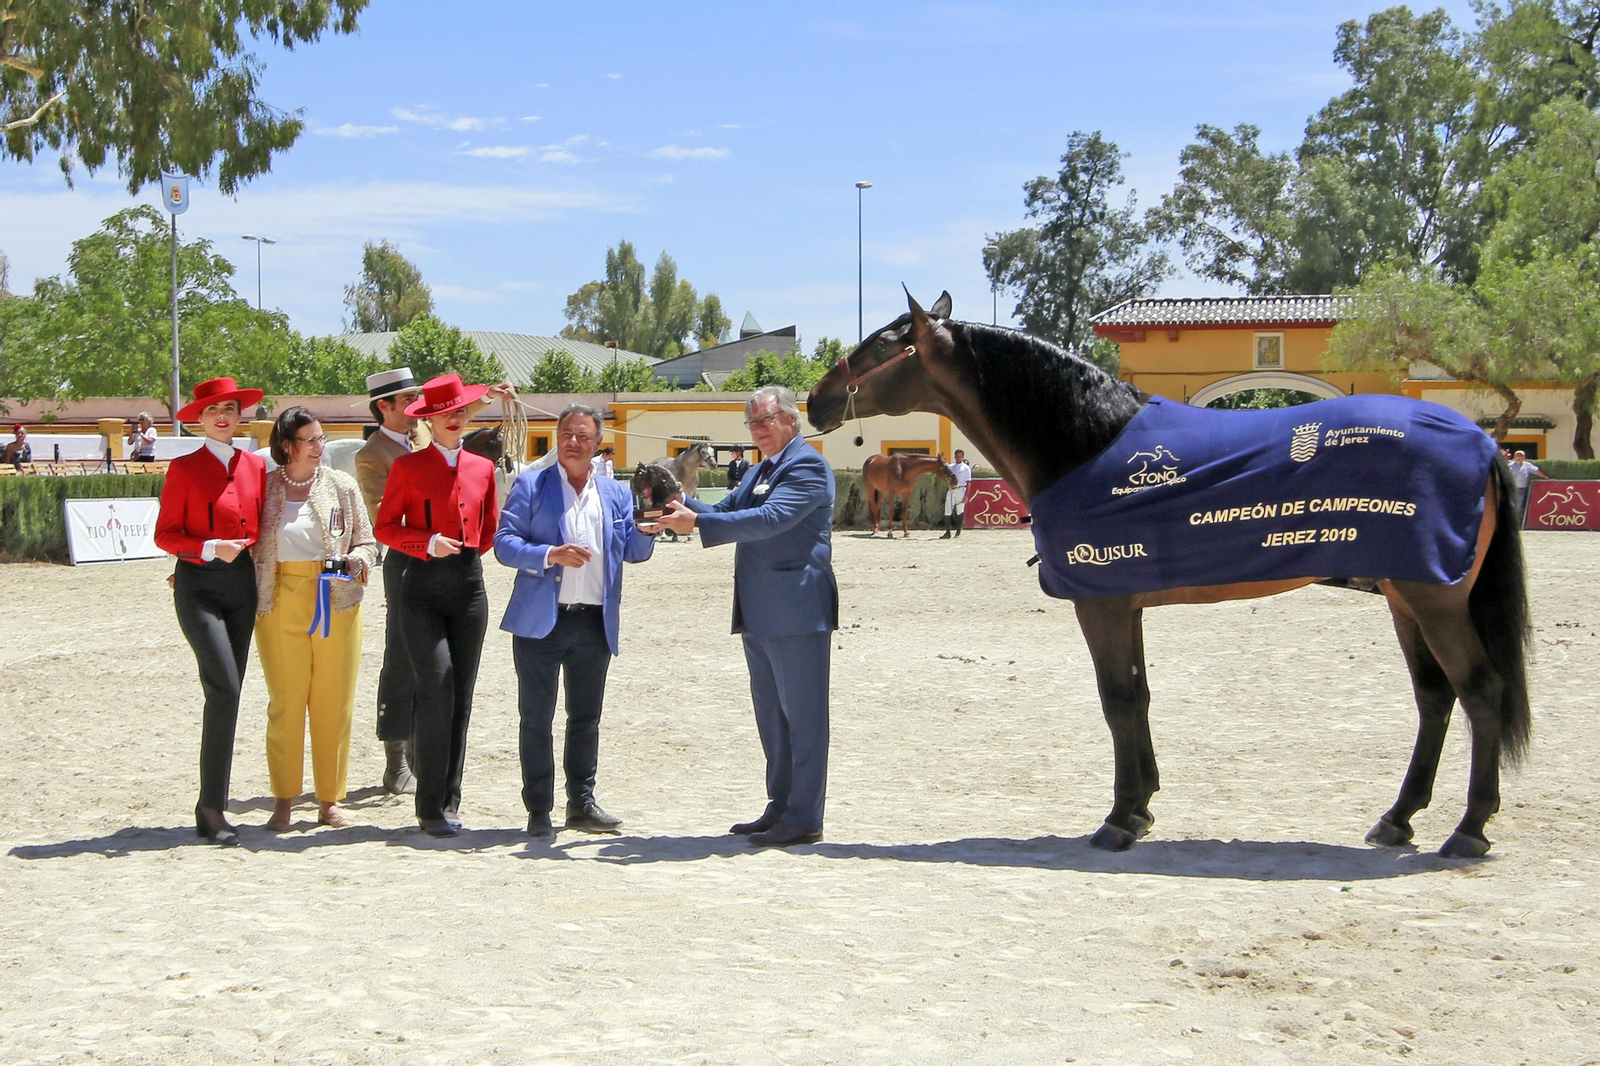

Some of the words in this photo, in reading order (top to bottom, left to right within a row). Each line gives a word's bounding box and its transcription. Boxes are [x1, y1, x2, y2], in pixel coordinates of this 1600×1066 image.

[1325, 426, 1405, 438] Ayuntamiento
[1324, 438, 1338, 447] de
[1340, 436, 1369, 447] Jerez
[1189, 503, 1277, 525] CAMPEÓN
[1281, 501, 1306, 517] DE
[1309, 498, 1417, 517] CAMPEONES
[86, 525, 107, 539] TIO
[123, 524, 149, 537] PEPE
[1261, 530, 1317, 548] JEREZ
[1320, 527, 1358, 543] 2019
[1066, 543, 1148, 566] EQUISUR
